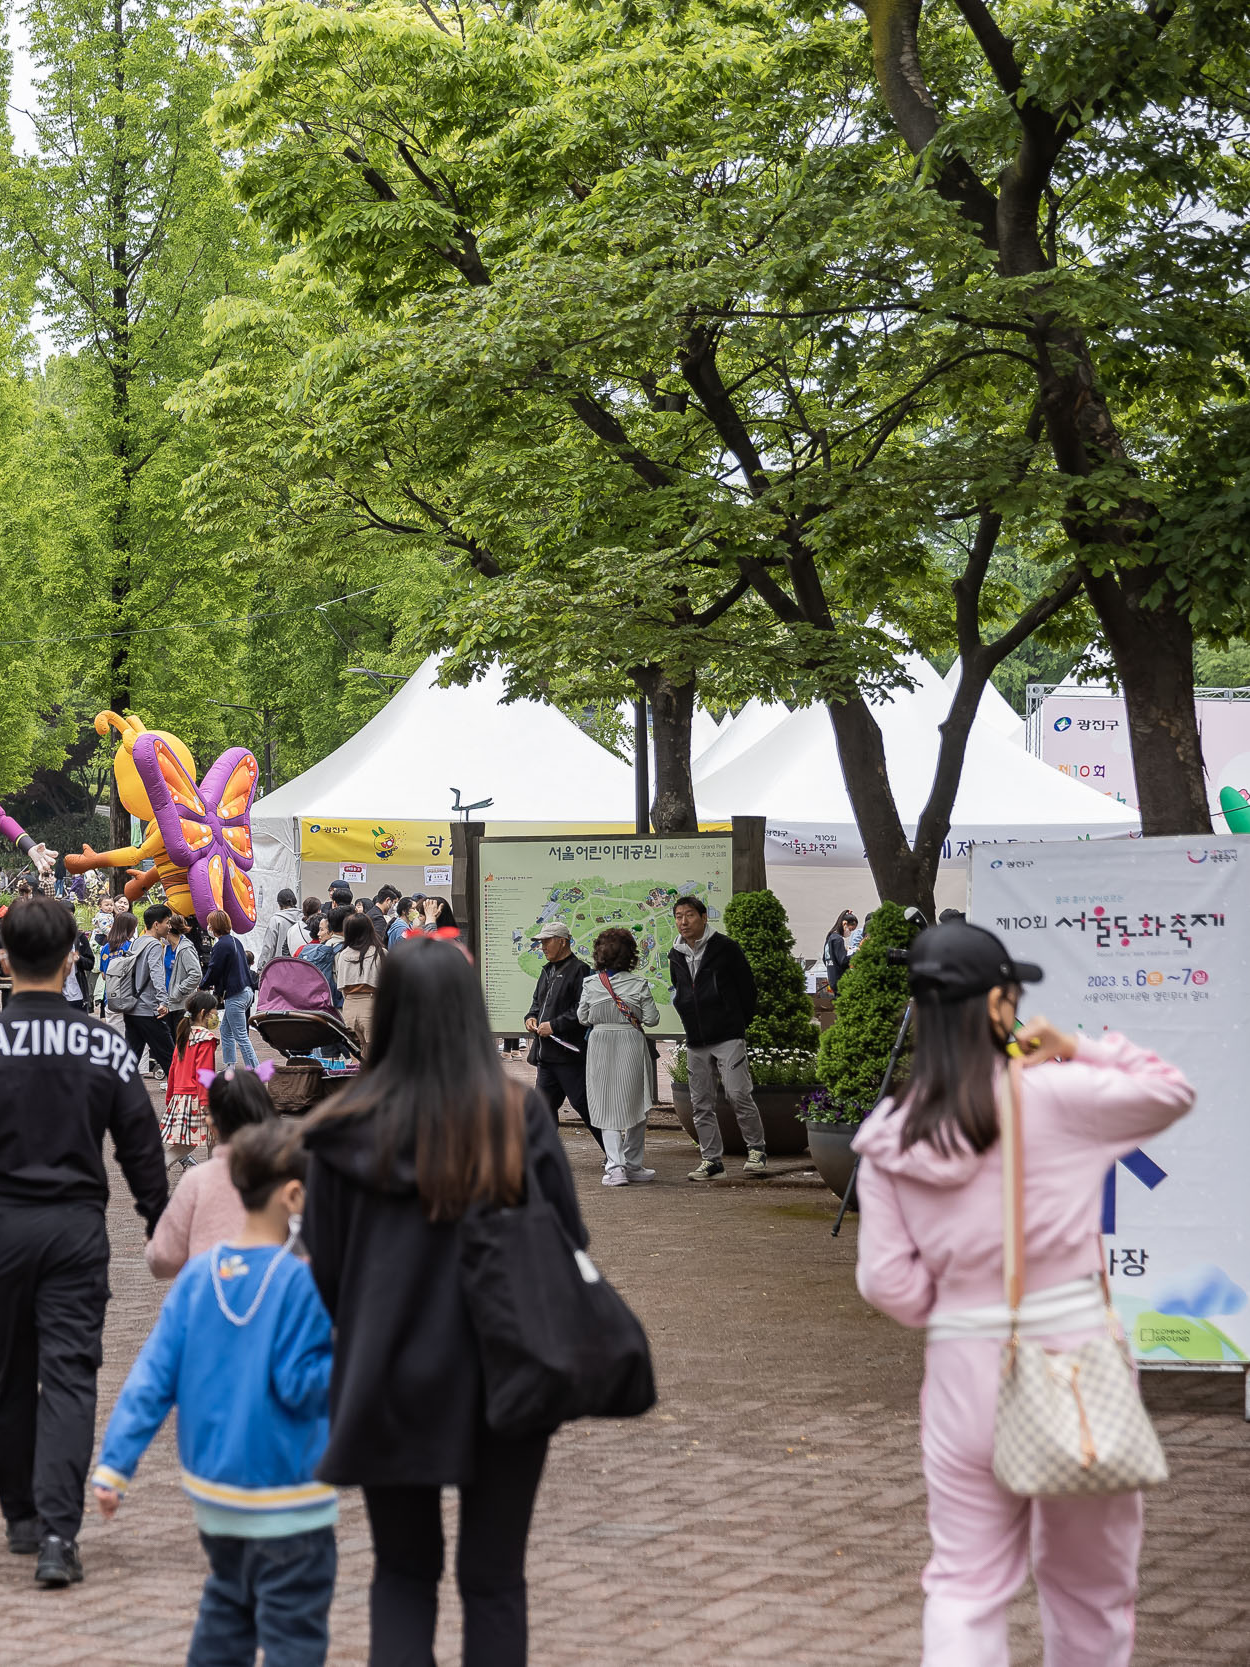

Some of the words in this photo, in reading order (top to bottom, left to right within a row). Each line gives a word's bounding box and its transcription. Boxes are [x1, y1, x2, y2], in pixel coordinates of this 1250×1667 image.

[1076, 719, 1120, 731] 광진구
[322, 825, 349, 834] 광진구
[425, 834, 453, 857] 광
[781, 838, 838, 857] 서울동화축제
[549, 845, 658, 861] 서울어린이대공원
[1006, 860, 1035, 869] 광진구
[996, 915, 1048, 931] 제10회
[1055, 906, 1225, 949] 서울동화축제
[1087, 975, 1119, 988] 2023.
[1122, 976, 1133, 988] 5.
[1155, 1328, 1191, 1336] COMMON
[1155, 1335, 1191, 1343] GROUND
